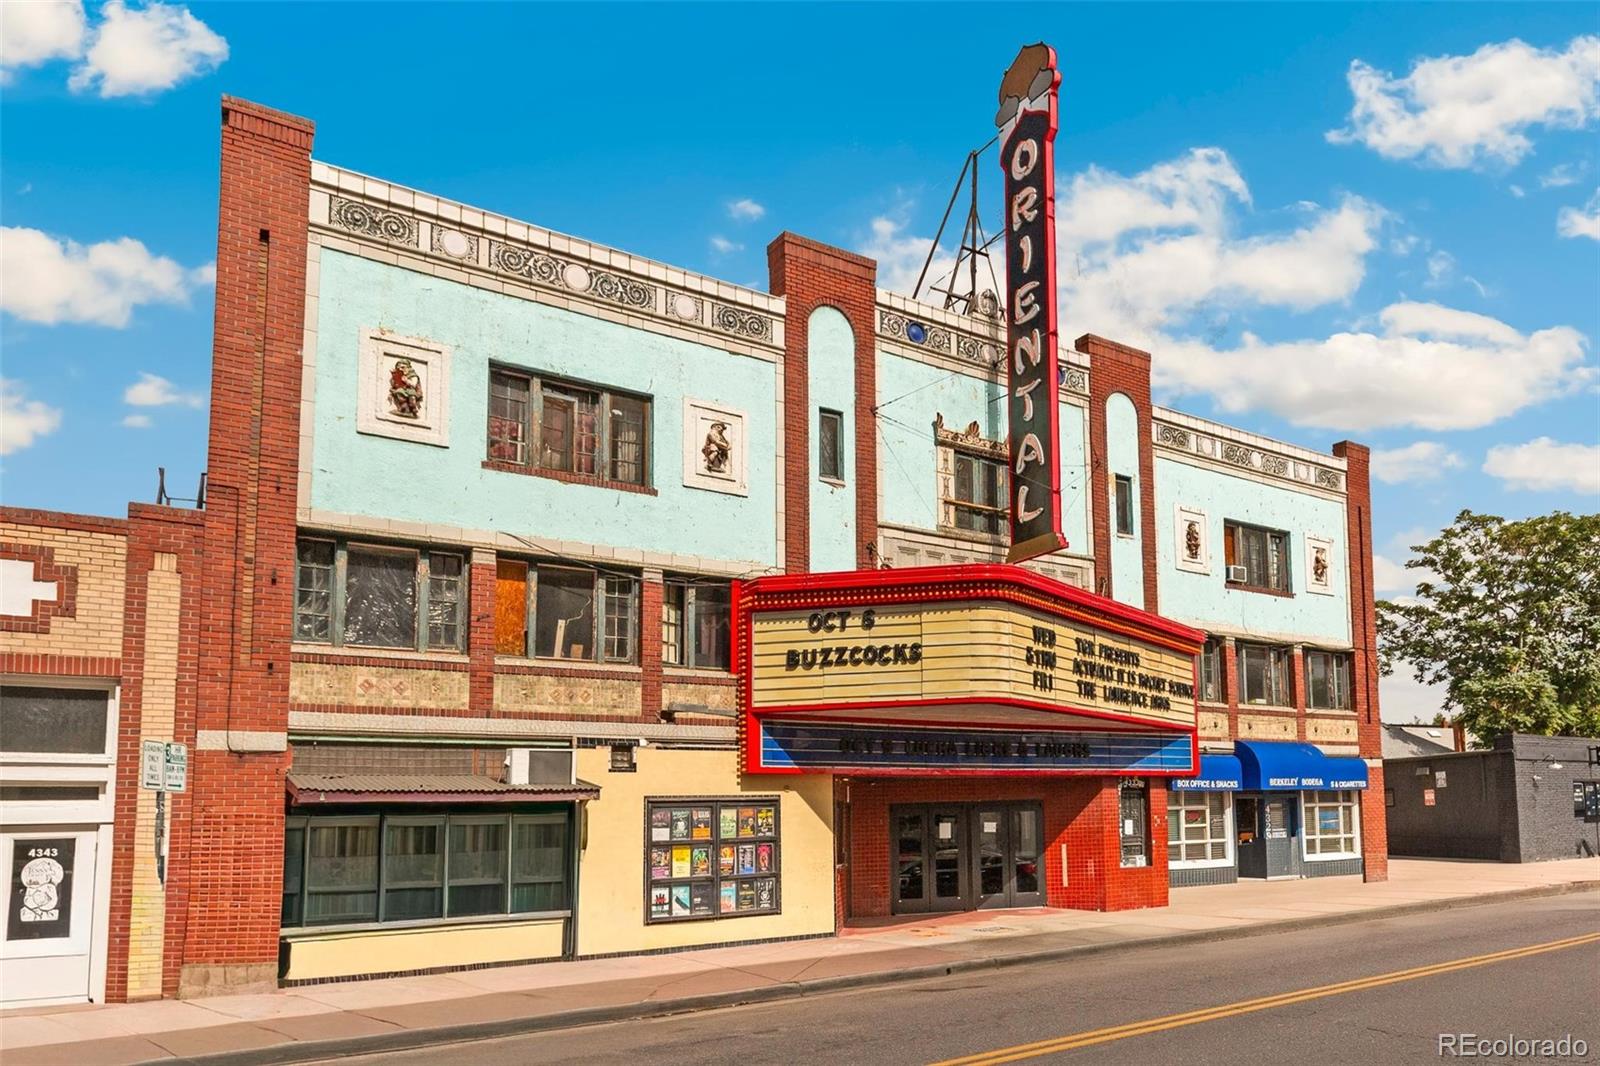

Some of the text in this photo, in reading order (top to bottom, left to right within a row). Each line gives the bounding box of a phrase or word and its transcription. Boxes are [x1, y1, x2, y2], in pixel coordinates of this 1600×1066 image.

[1011, 137, 1045, 524] ORIENTAL
[807, 611, 851, 633] OCT
[785, 642, 922, 671] BUZZCOCKS
[1032, 670, 1053, 693] FRI
[1077, 679, 1097, 700] THE
[1177, 779, 1190, 788] BOX
[1190, 780, 1210, 788] OFFICE
[1215, 780, 1239, 788] SNACKS
[1269, 777, 1298, 787] BERKELEY
[28, 848, 59, 858] 4343
